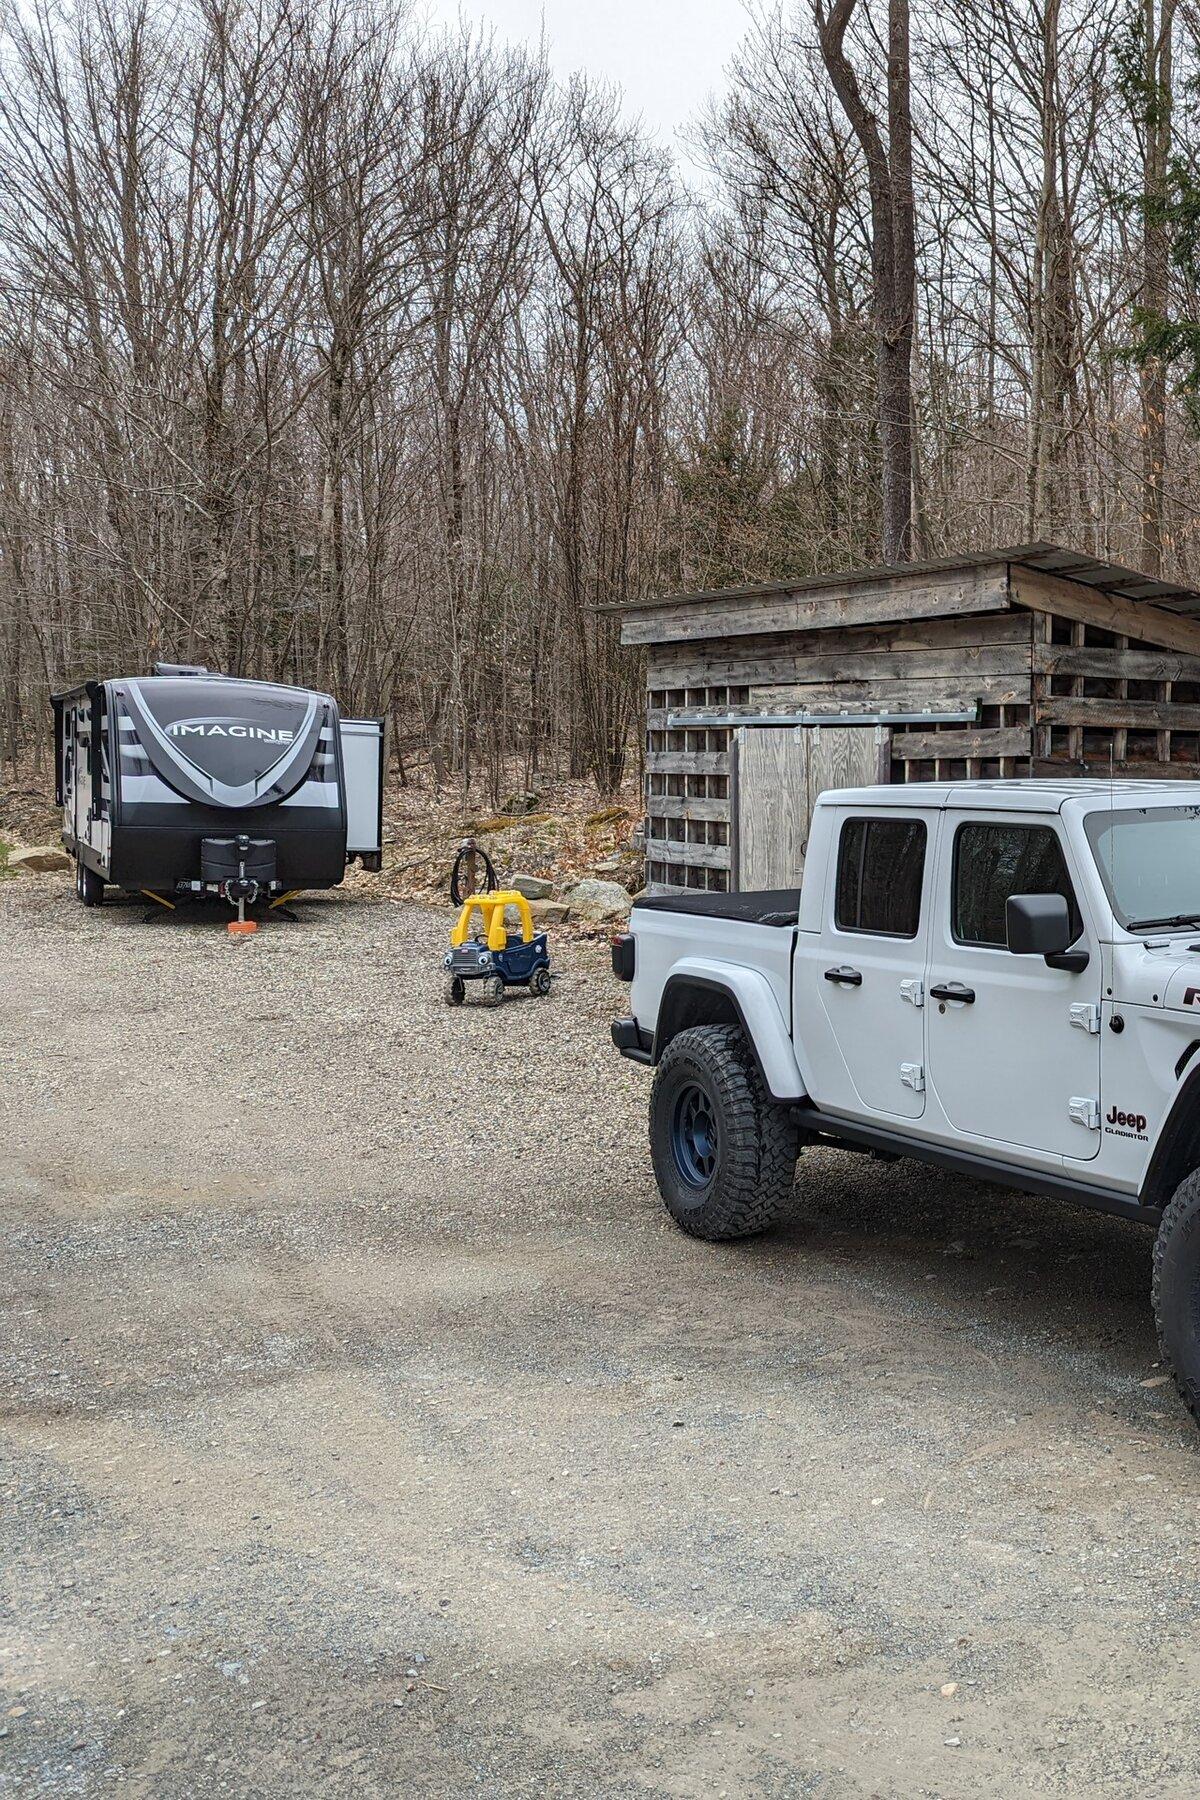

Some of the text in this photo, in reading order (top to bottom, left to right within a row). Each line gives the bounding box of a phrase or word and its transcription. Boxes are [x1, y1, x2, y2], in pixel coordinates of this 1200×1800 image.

[172, 724, 294, 741] IMAGINE
[1106, 1105, 1147, 1133] Jeep
[1104, 1126, 1149, 1142] GLADIATOR
